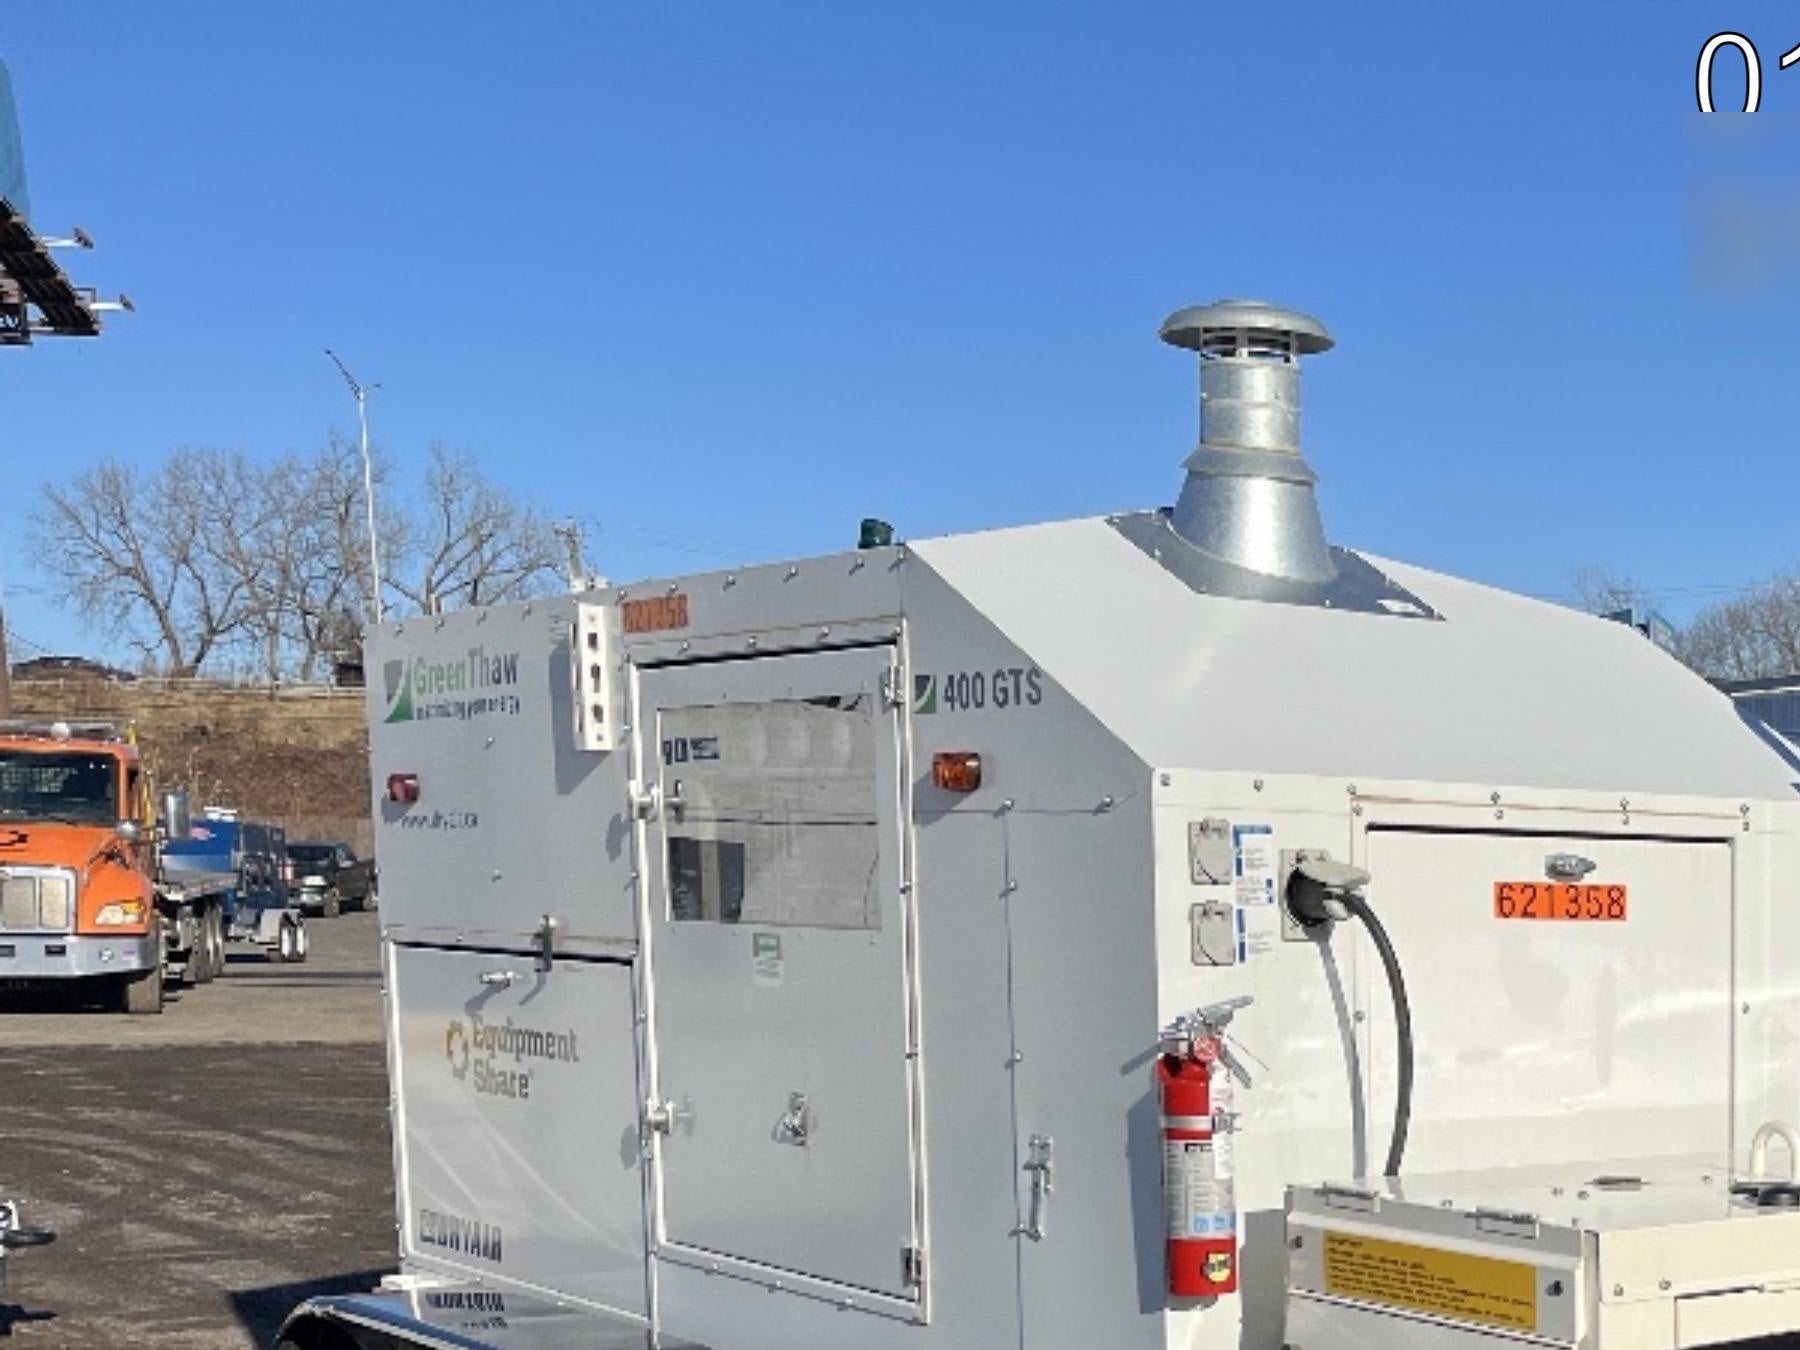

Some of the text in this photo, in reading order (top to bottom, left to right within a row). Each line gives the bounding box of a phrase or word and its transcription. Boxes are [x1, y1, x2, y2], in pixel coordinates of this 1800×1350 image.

[944, 667, 1042, 711] 400 GTS
[1498, 882, 1625, 919] 621358
[471, 1013, 580, 1063] Equipment
[473, 1058, 530, 1099] Share
